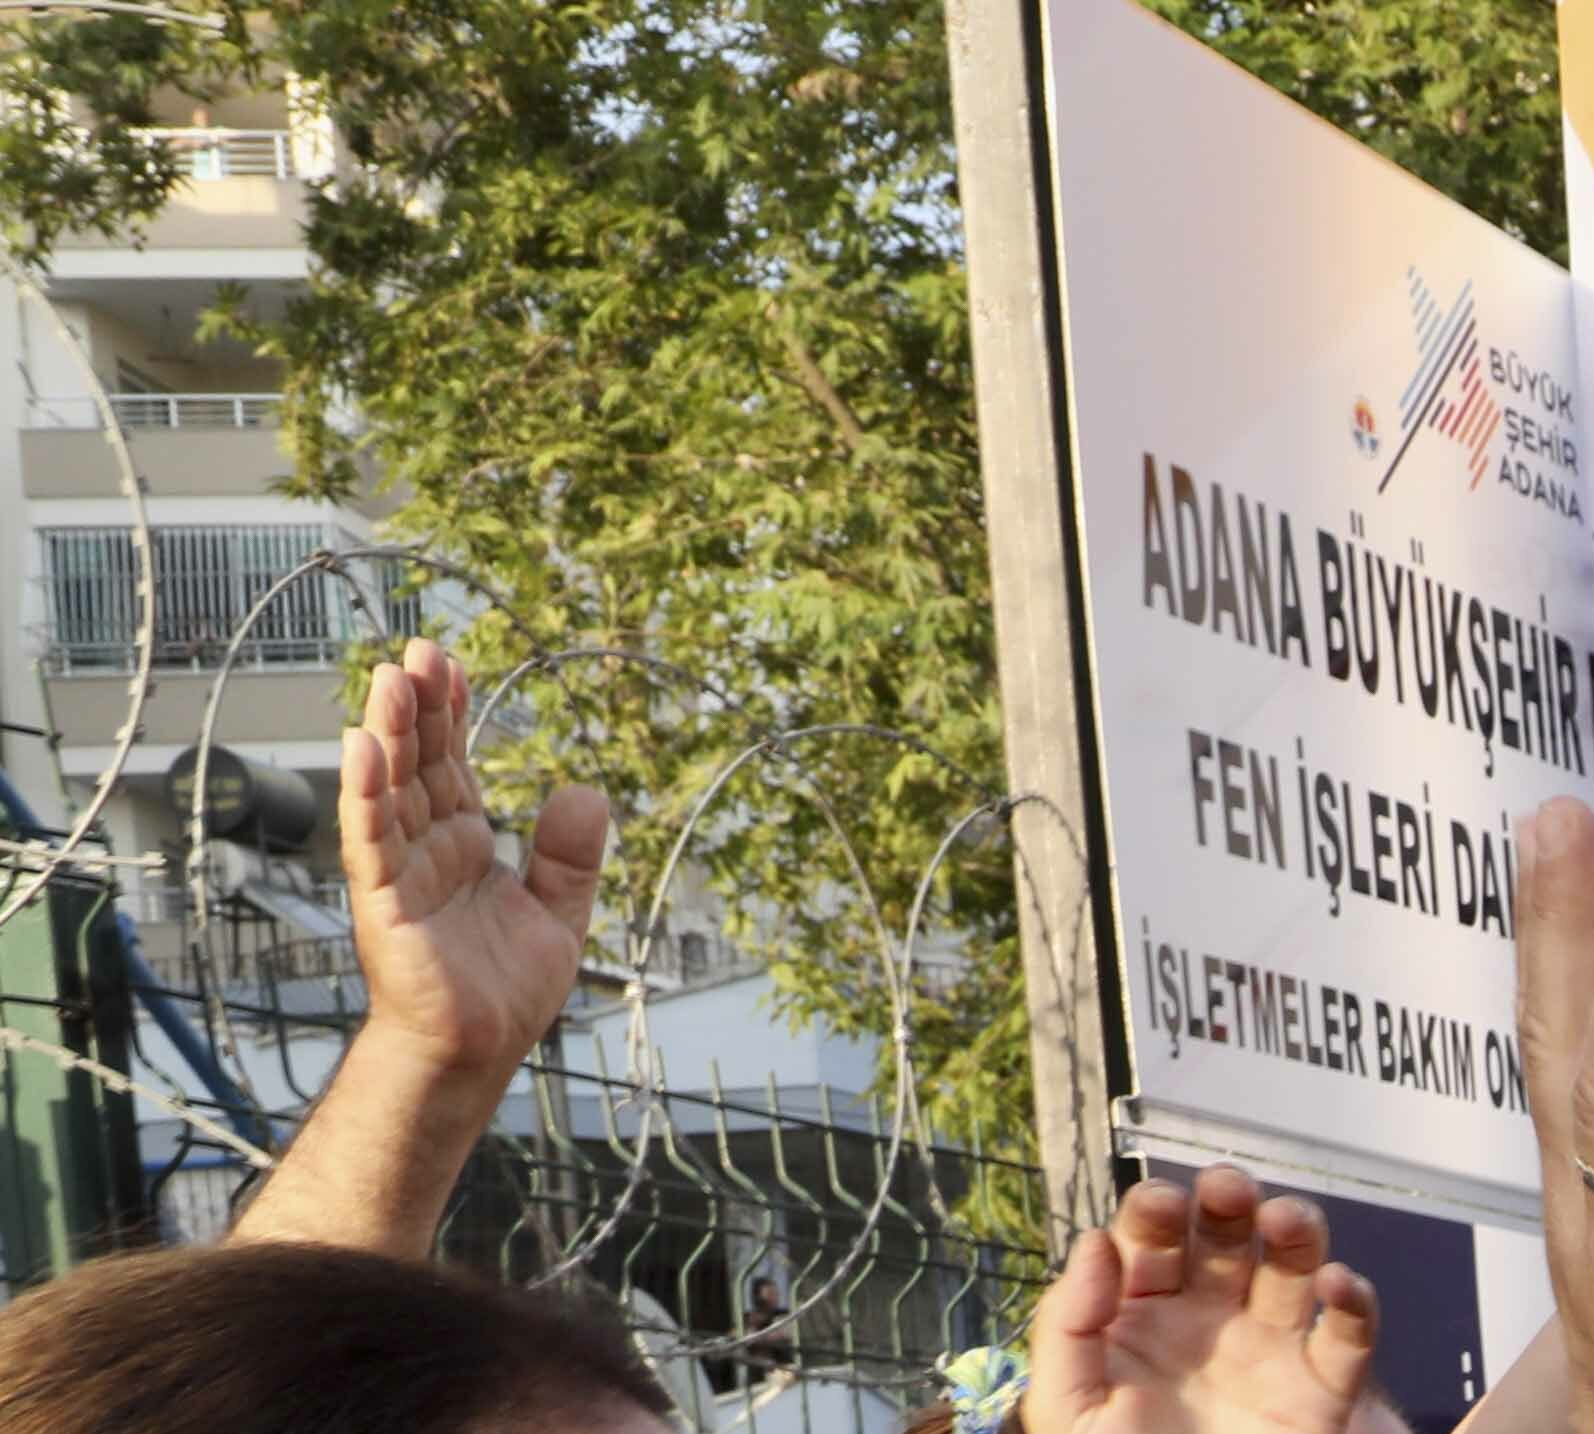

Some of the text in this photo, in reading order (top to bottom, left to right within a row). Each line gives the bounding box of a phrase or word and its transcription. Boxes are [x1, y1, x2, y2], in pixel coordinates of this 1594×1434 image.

[1489, 346, 1575, 422] BÜYÜK
[1503, 406, 1579, 477] ŞEHİR
[1498, 455, 1584, 526] ADANA
[1141, 452, 1311, 671] ADANA
[1316, 511, 1586, 777] BÜYÜKŞEHİR
[1186, 728, 1287, 871] FEN
[1296, 737, 1440, 917] İŞLERİ
[1142, 916, 1368, 1077] İŞLETMELER
[1373, 1000, 1477, 1103] BAKIM
